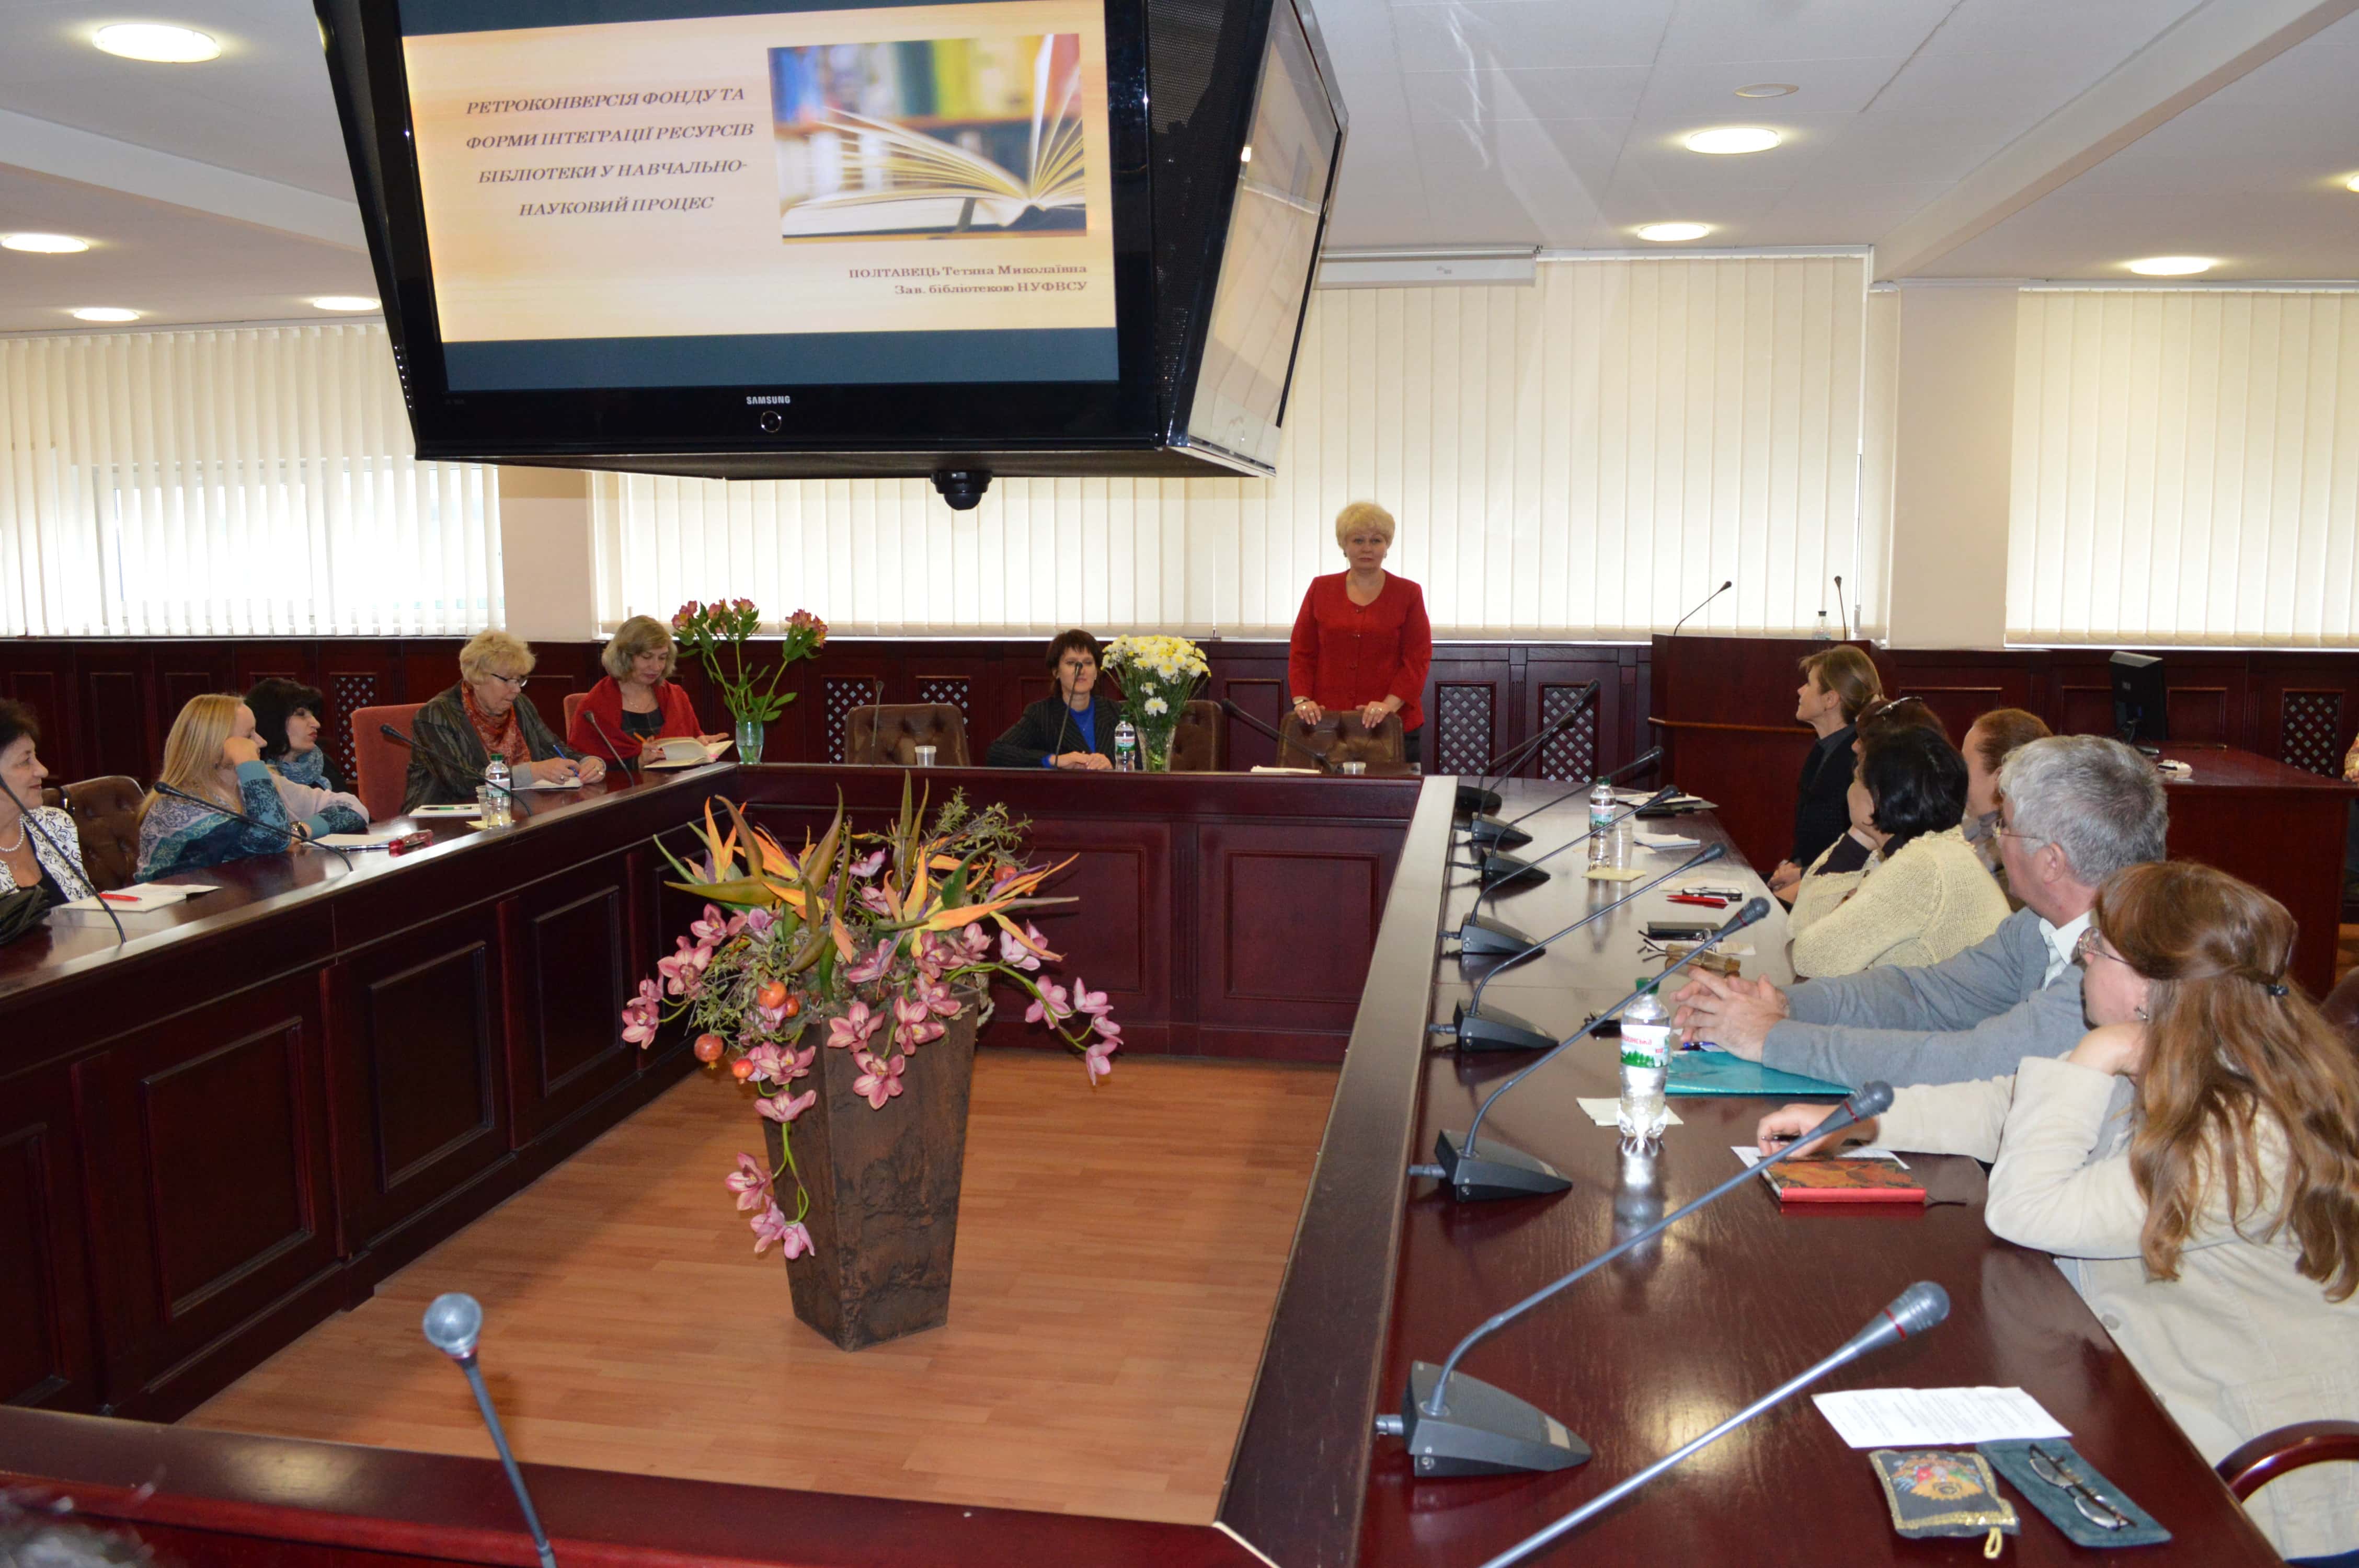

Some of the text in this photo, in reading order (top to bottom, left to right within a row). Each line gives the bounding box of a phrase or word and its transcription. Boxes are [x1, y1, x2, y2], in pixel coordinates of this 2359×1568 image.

[466, 88, 745, 114] РЕТРОКОНВЕРСІЯ ФОНДУ ТА
[466, 123, 754, 148] ФОРМИ ІНТЕГРАЦІЇ РЕСУРСІВ
[478, 159, 748, 183] БІБЛІОТЕКИ У НАВЧАЛЬНО-
[519, 196, 714, 216] НАУКОВИЙ ПРОЦЕС
[849, 264, 1087, 278] ПОЛТАВЕЦЬ Тетяна Миколаївна
[895, 281, 1087, 294] Зав. бібліотекою НУФВСУ
[746, 396, 791, 405] SAMSUNG
